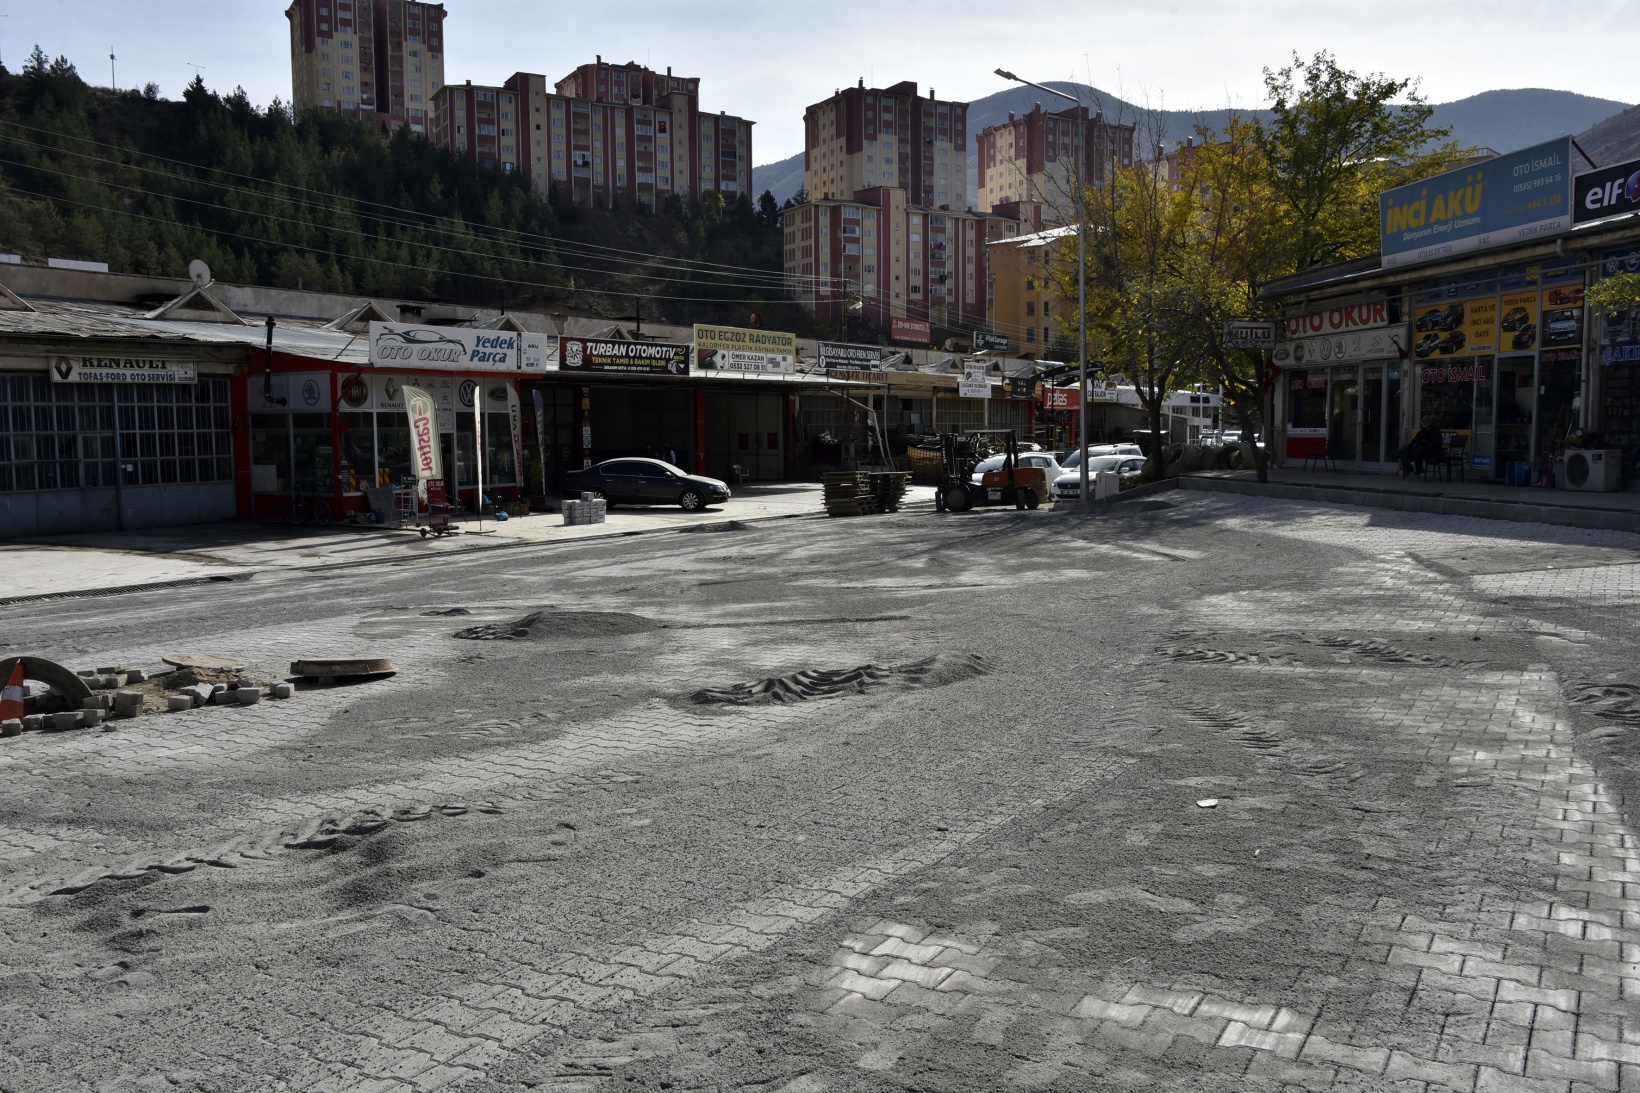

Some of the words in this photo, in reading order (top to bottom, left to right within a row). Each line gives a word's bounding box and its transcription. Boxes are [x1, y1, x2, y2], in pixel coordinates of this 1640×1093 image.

[1513, 165, 1530, 178] OTO
[1531, 152, 1562, 173] İSMAİL
[1533, 177, 1544, 189] 983
[1585, 178, 1625, 210] elf
[1386, 189, 1427, 235] İNCİ
[1429, 171, 1483, 223] AKÜ
[1403, 228, 1432, 242] Dünyanın
[1433, 221, 1453, 235] Enerji
[1454, 216, 1481, 230] Uzmanı
[1417, 250, 1428, 260] OTO
[1518, 226, 1539, 238] YEDEK
[1540, 221, 1562, 233] PARÇA
[1470, 305, 1487, 314] VARTA
[1503, 298, 1519, 306] YEDEK
[1286, 311, 1323, 336] OTO
[1329, 301, 1386, 330] OKUR
[475, 336, 517, 350] Yedek
[698, 329, 716, 340] OTO
[718, 331, 747, 343] EGZOZ
[748, 333, 793, 347] RADYATÖR
[377, 345, 413, 360] OTO
[417, 346, 462, 363] OKUR
[586, 342, 628, 357] TURBAN
[754, 345, 776, 353] KAYNAK
[81, 357, 169, 370] RENAULT
[470, 350, 508, 366] Parça
[591, 356, 612, 365] TEKNİK
[612, 356, 629, 365] TAMİR
[731, 352, 747, 361] ÖMER
[747, 354, 765, 362] KAZAN
[730, 362, 743, 370] 0532
[1422, 367, 1446, 384] OTO
[1447, 363, 1486, 383] İSMAİL
[128, 373, 146, 382] OTO
[147, 371, 176, 383] SERVİSİ
